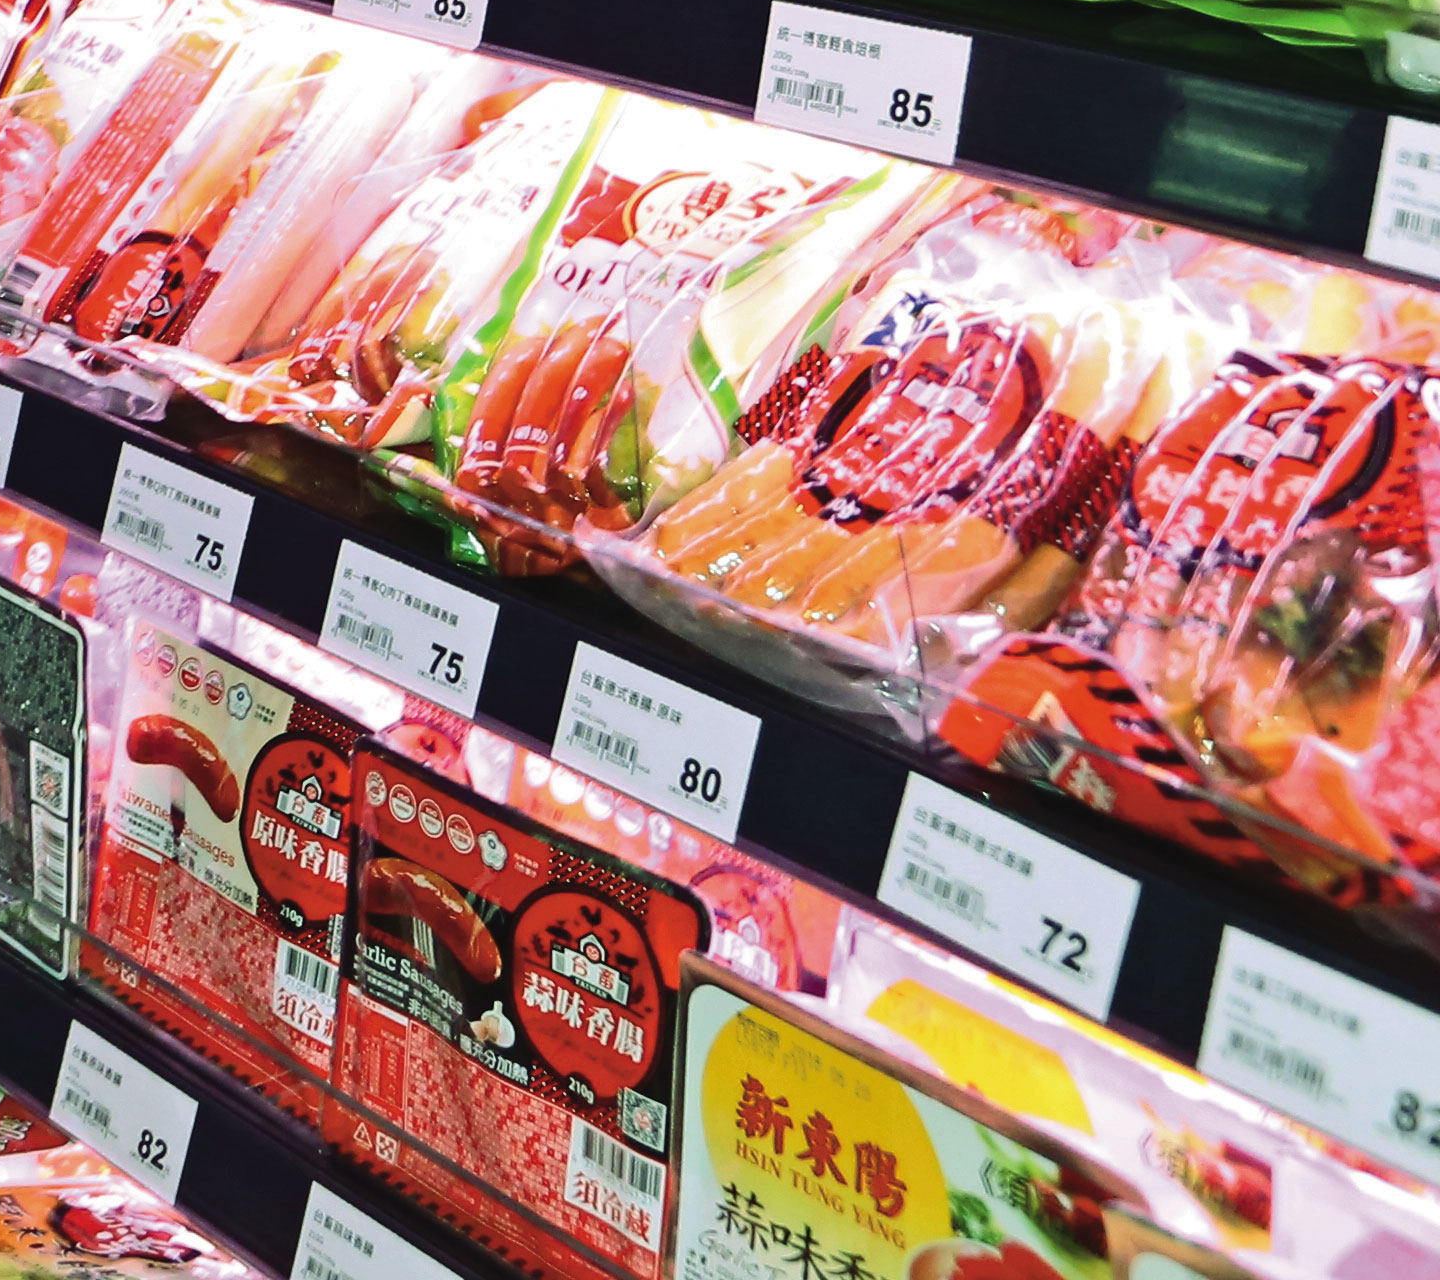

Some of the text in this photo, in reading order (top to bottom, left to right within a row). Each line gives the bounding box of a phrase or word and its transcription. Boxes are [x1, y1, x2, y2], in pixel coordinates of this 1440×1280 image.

[889, 87, 934, 130] 85
[192, 533, 225, 573] 75
[427, 642, 467, 685] 75
[678, 756, 723, 804] 80
[1038, 916, 1090, 973] 72
[400, 957, 464, 1015] Sausages
[522, 970, 646, 1064] 蒜味香腸
[136, 1129, 168, 1170] 82
[734, 1071, 908, 1219] 新東陽
[734, 1139, 907, 1252] HSIN TUNG YANG
